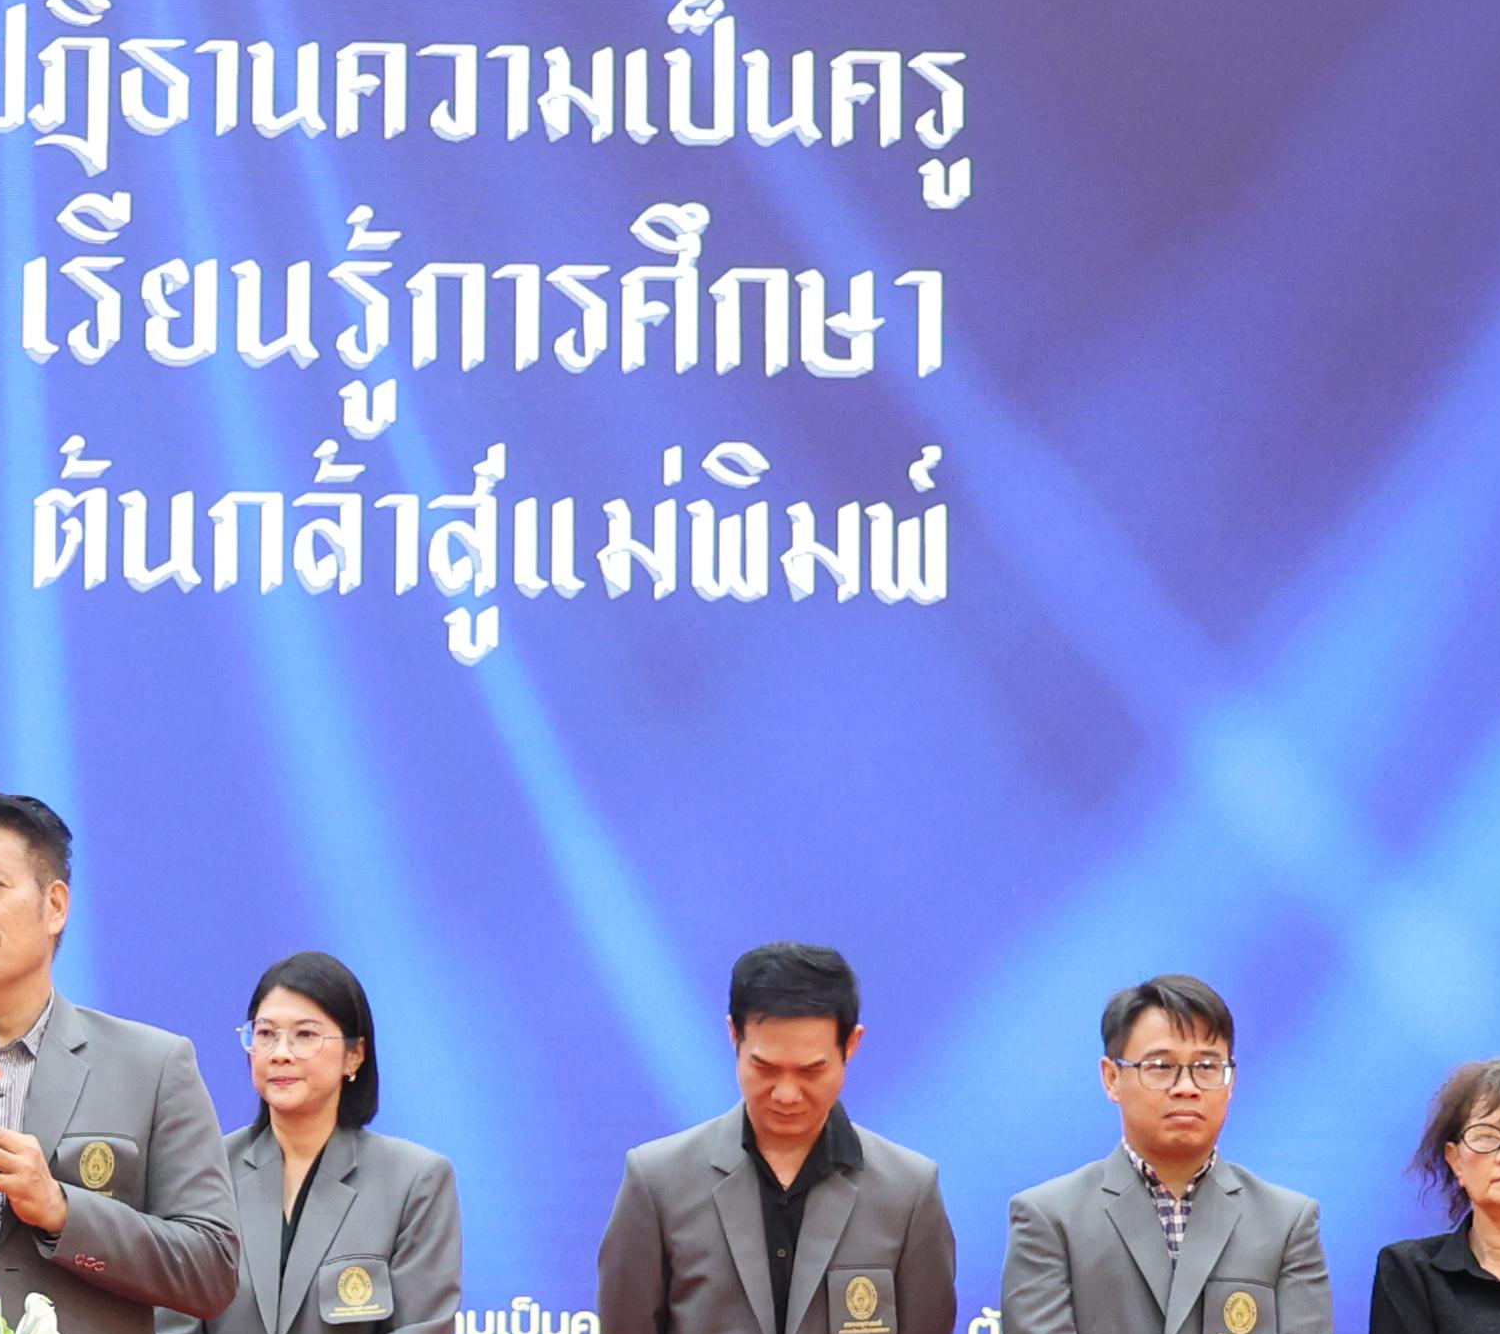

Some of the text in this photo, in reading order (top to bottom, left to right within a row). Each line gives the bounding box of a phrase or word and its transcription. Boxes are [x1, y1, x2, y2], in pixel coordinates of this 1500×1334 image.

[21, 191, 944, 437] เรียนรู้การศึกษา
[32, 434, 948, 665] ต้นกล้าสู่แม่พิมพ์
